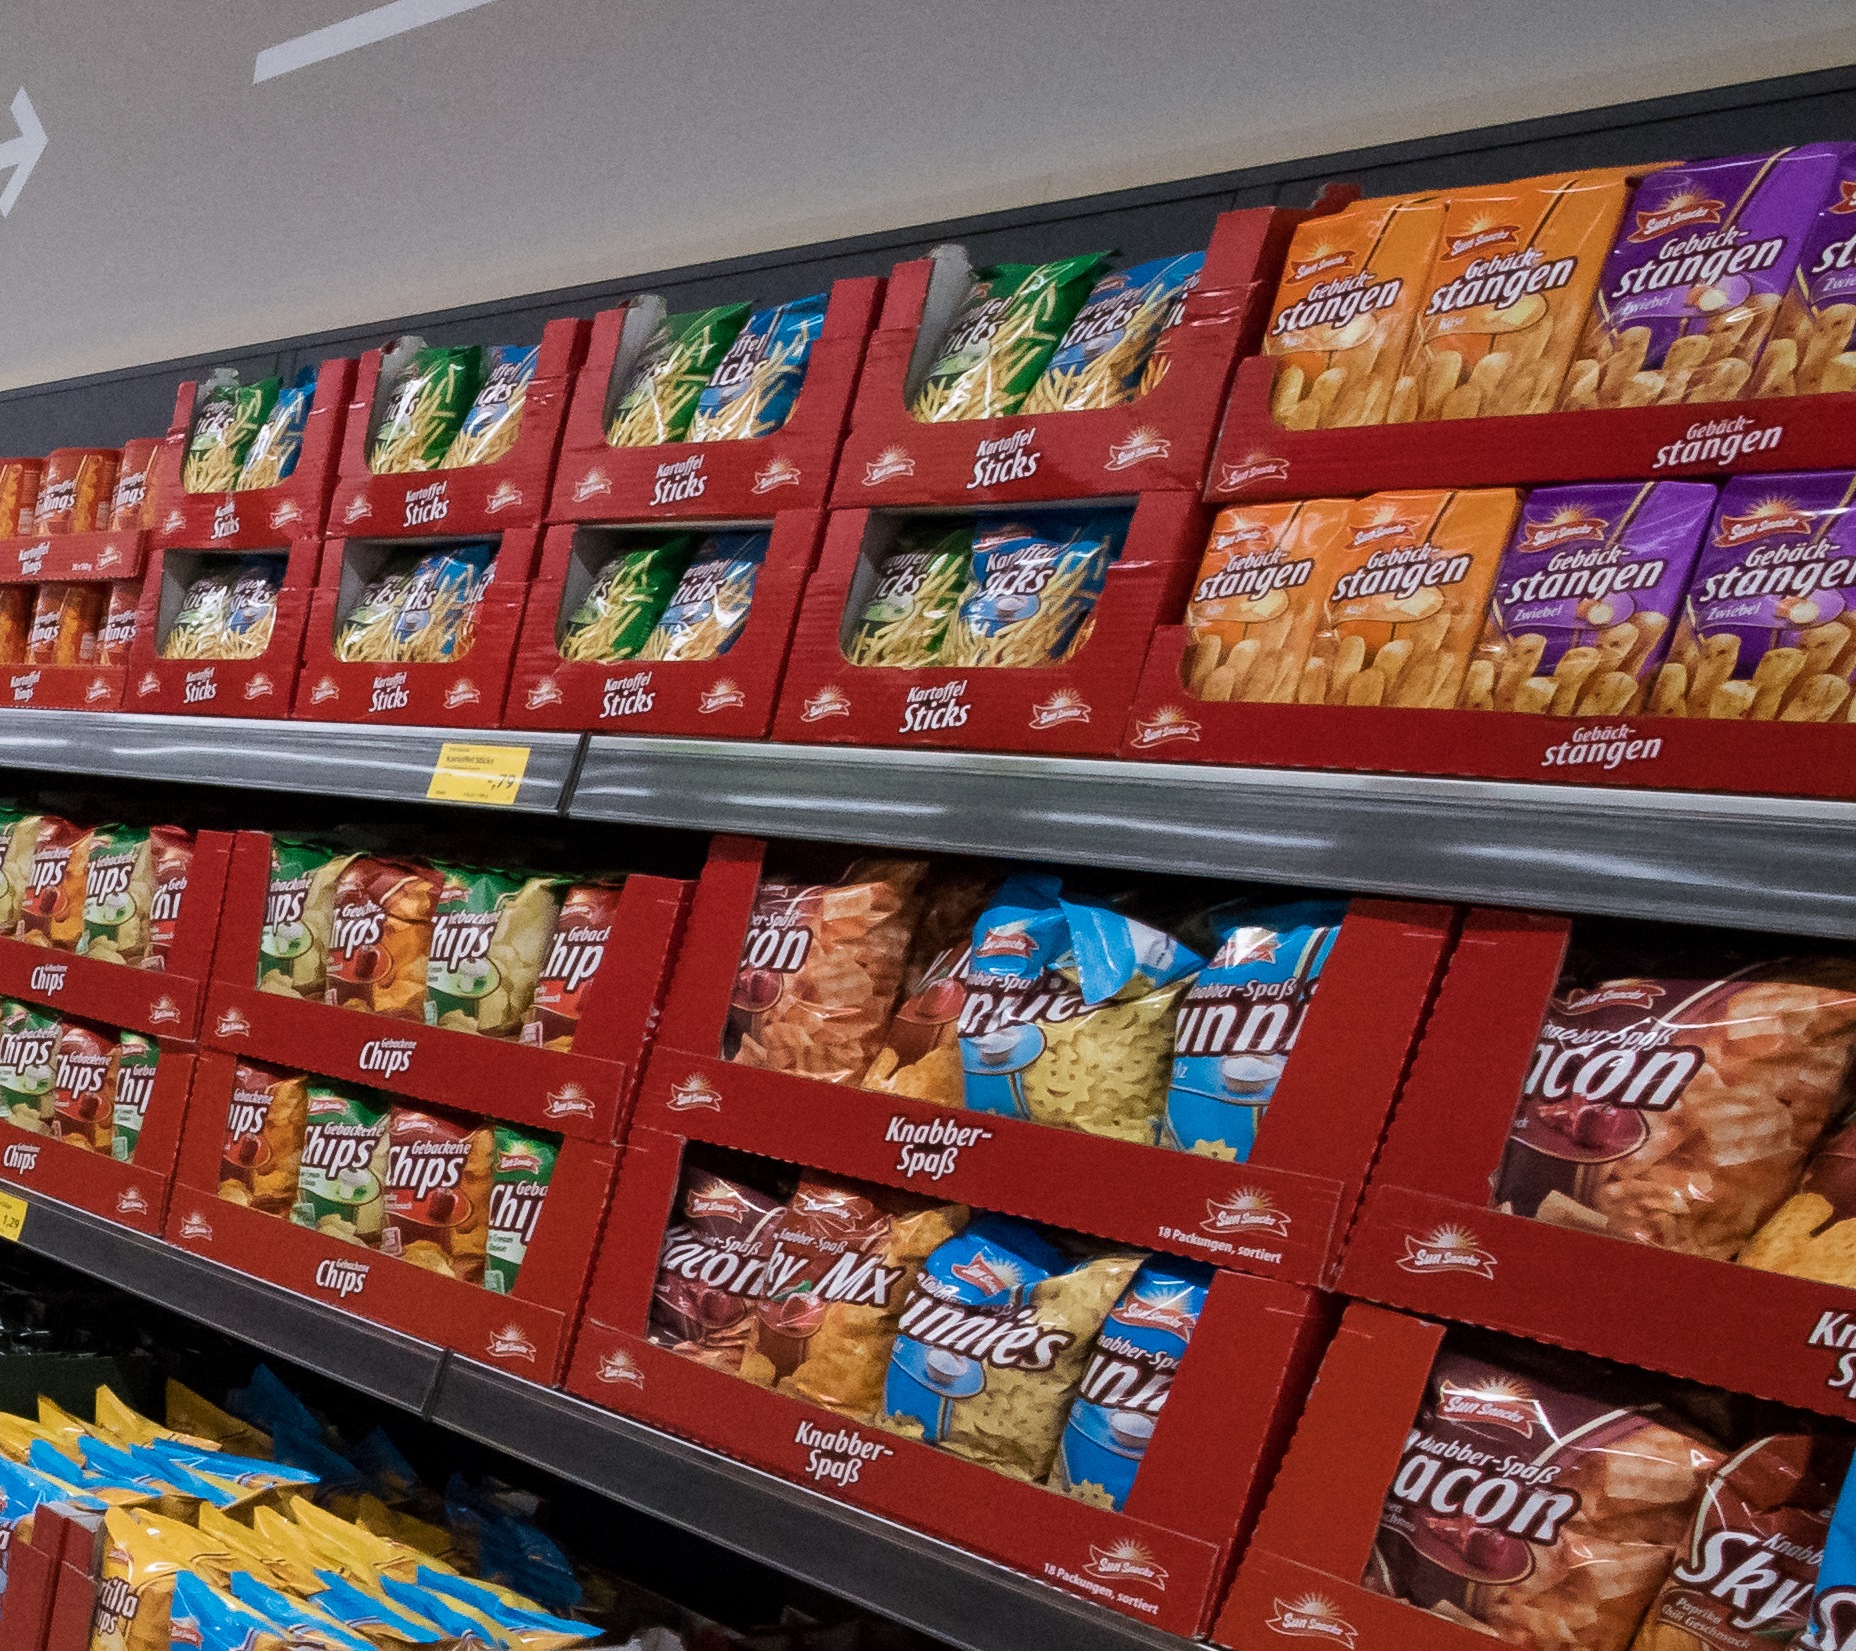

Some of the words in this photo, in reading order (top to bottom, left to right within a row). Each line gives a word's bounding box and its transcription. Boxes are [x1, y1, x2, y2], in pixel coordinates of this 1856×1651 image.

[1658, 228, 1749, 262] Gebäck-
[1465, 245, 1543, 281] Gebäck-
[1611, 236, 1785, 304] stangen
[1307, 270, 1375, 300] Gebäck-
[1426, 253, 1580, 317] stangen
[1271, 277, 1403, 335] stangen
[977, 427, 1036, 458] Kartoffel
[1686, 416, 1755, 441] Gebäck-
[655, 453, 705, 478] Kartoffel
[1653, 425, 1783, 473] stangen
[967, 449, 1040, 491] Sticks
[405, 480, 448, 503] Kartoffel
[649, 469, 707, 506] Sticks
[403, 499, 449, 528] Sticks
[1226, 545, 1288, 573] Gebäck-
[1366, 543, 1438, 571] Gebäck-
[1547, 546, 1630, 573] Gebäck-
[1744, 541, 1839, 573] Gebäck-
[1195, 557, 1313, 605] stangen
[1331, 554, 1470, 606] stangen
[1504, 556, 1664, 612] stangen
[1513, 604, 1562, 624] Zwiebel
[1706, 603, 1761, 624] Zwiebel
[183, 681, 218, 705] Sticks
[602, 670, 653, 694] Kartoffel
[907, 679, 968, 705] Kartoffel
[368, 685, 411, 713] Sticks
[599, 687, 656, 720] Sticks
[899, 698, 971, 734] Sticks
[1570, 725, 1636, 745] Gebäck-
[1541, 735, 1662, 769] stangen
[31, 966, 65, 994] Chips
[358, 1042, 414, 1078] Chips
[411, 1139, 471, 1158] Gebackene
[886, 1114, 993, 1152] Knabber-
[3, 1145, 37, 1175] Chips
[897, 1143, 960, 1180] Spaß
[1158, 1225, 1170, 1239] 18
[1172, 1228, 1235, 1256] Packungen,
[1237, 1244, 1282, 1266] sortiert
[315, 1258, 367, 1297] Chips
[794, 1420, 896, 1463] Knabber-
[805, 1449, 864, 1487] Spaß
[1393, 1435, 1580, 1541] acon
[1120, 1590, 1160, 1617] sortiert
